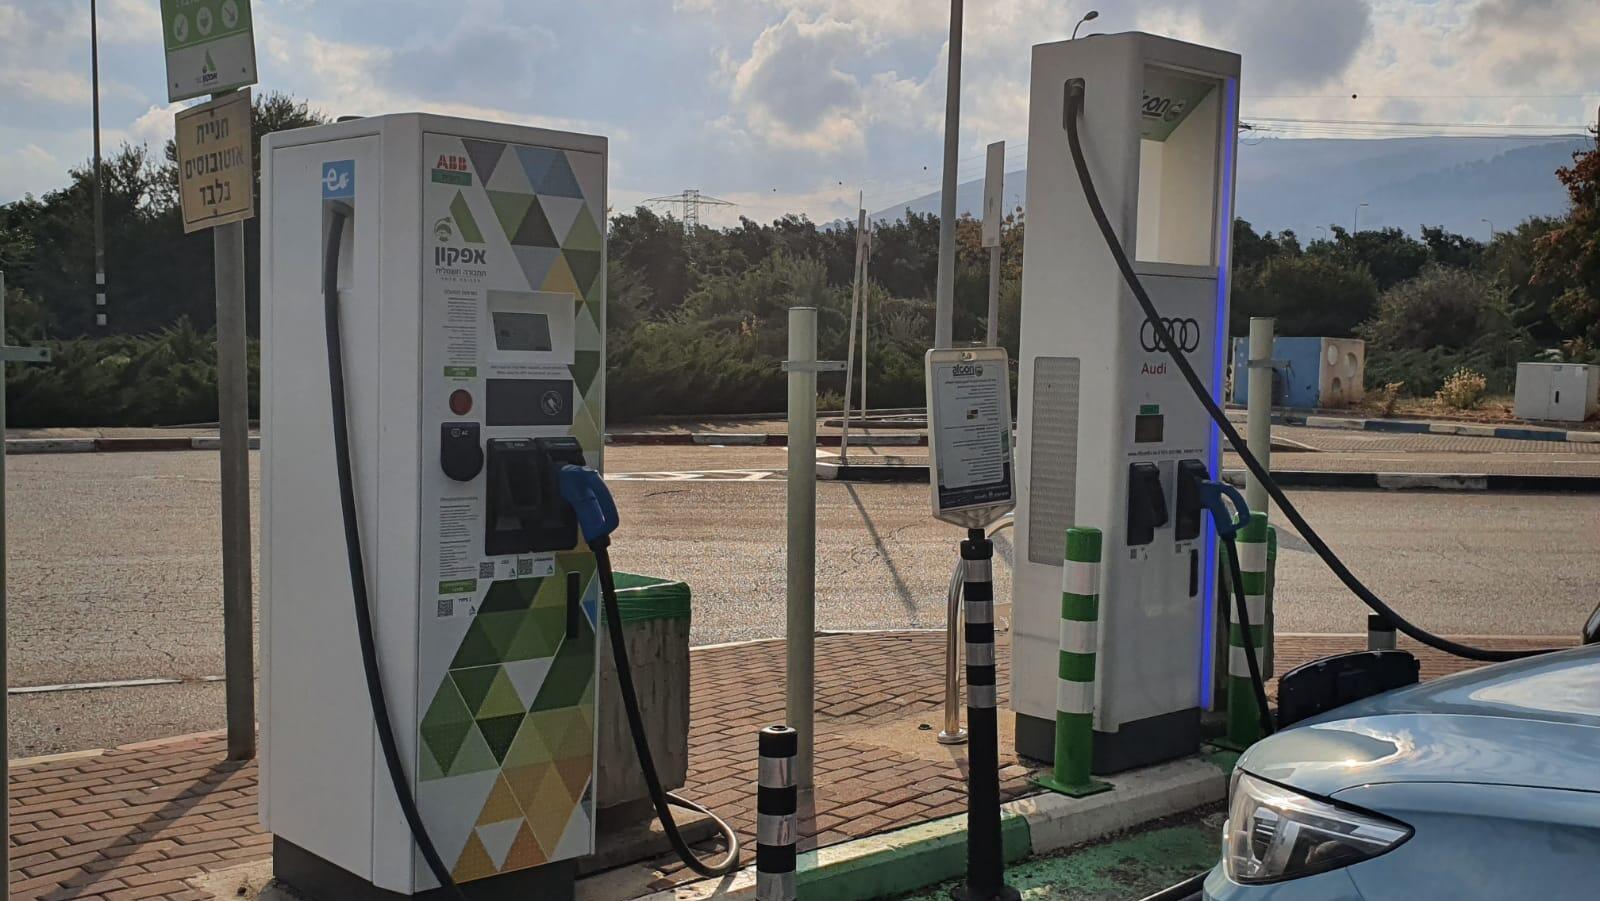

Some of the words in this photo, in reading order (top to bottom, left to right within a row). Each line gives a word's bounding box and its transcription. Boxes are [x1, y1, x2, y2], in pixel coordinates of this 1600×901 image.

[196, 118, 229, 144] חניית
[185, 145, 244, 179] אוטובוסים
[437, 154, 468, 171] ABB
[435, 246, 487, 267] אפקון
[1141, 362, 1167, 375] Audi
